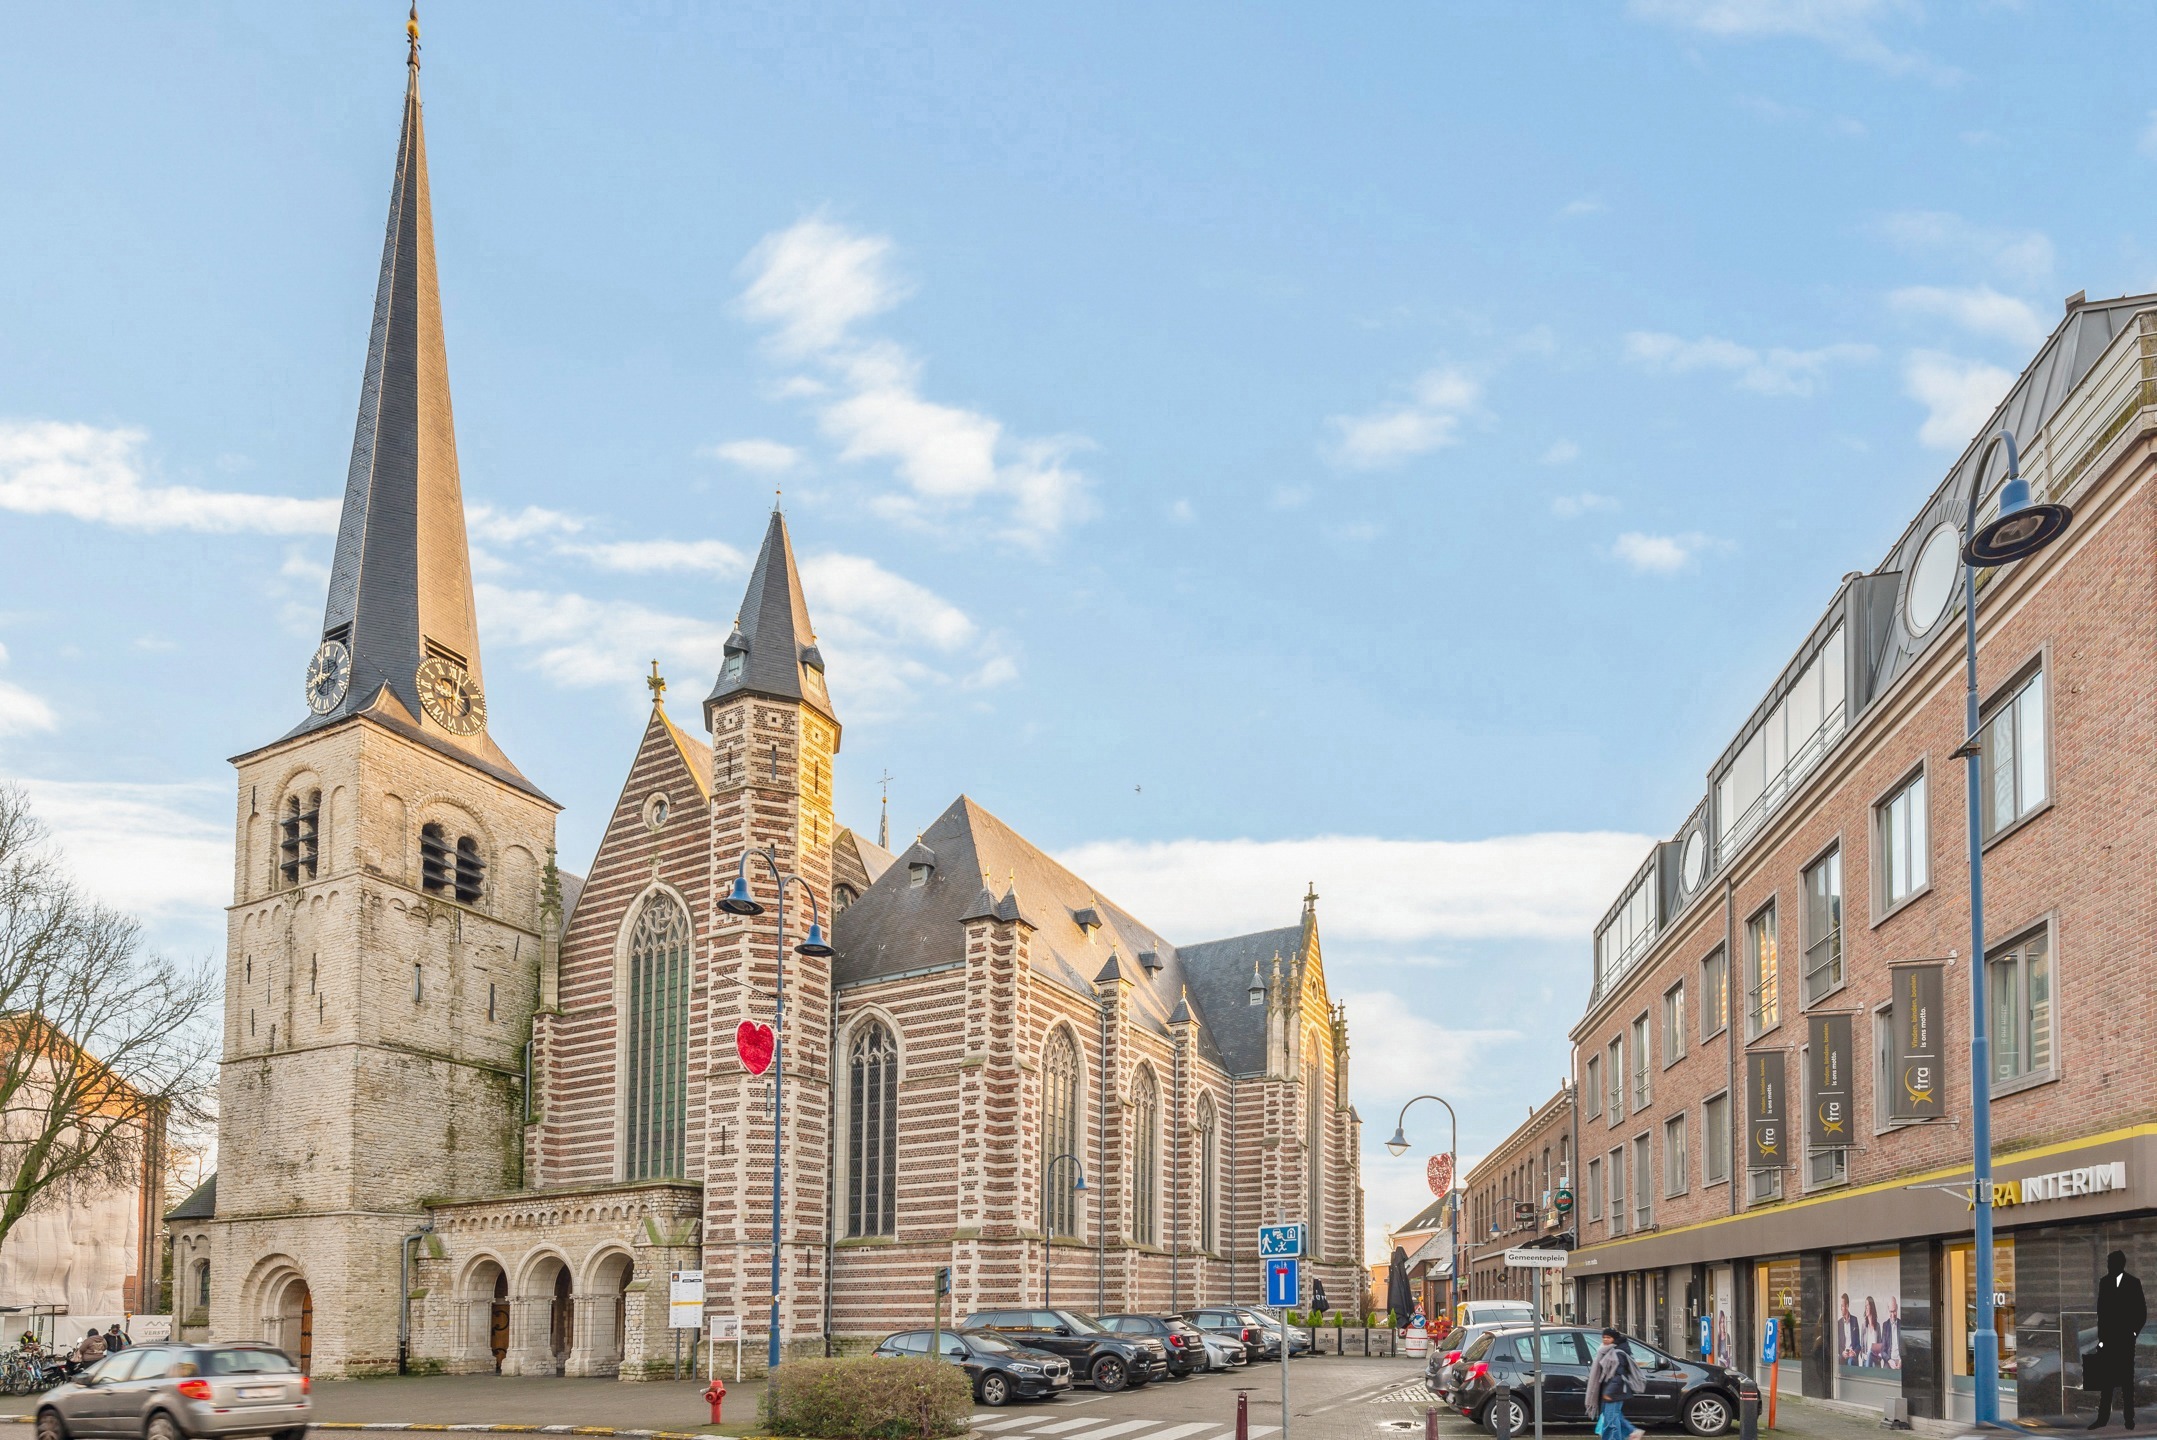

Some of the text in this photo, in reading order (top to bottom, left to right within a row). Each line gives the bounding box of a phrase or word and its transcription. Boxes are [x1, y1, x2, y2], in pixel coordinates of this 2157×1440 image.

[1919, 1006, 1927, 1028] motto.
[1966, 1161, 2127, 1211] XRA INTERIM
[1508, 1254, 1565, 1263] Gemeenteplein
[1701, 1320, 1709, 1347] P
[1766, 1321, 1774, 1345] P
